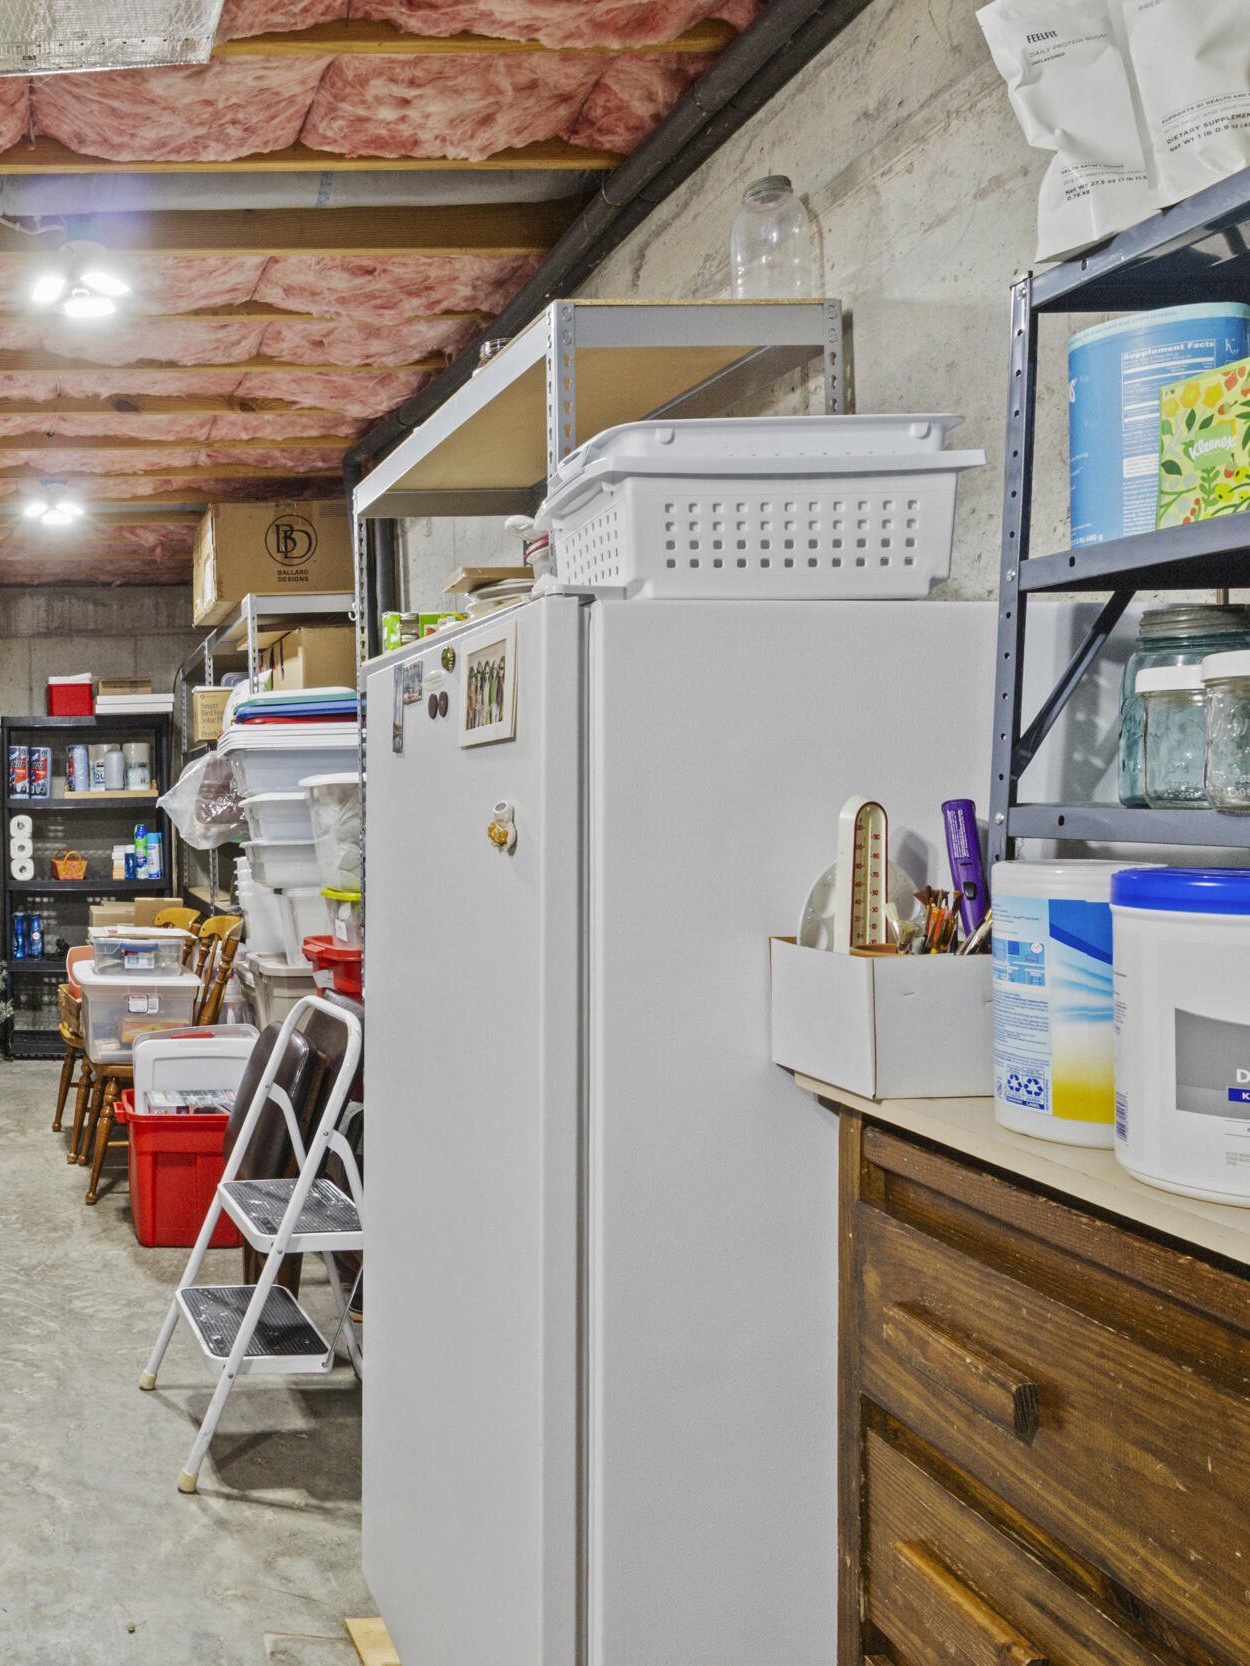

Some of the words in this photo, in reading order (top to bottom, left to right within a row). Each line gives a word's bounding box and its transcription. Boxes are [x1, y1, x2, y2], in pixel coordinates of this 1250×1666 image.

[1026, 30, 1058, 44] FEELFIT
[1029, 46, 1050, 58] DAILY
[1166, 124, 1200, 145] DIETARY
[1123, 343, 1184, 360] Supplement
[1188, 341, 1214, 350] Facts
[1188, 435, 1237, 460] Kleenex
